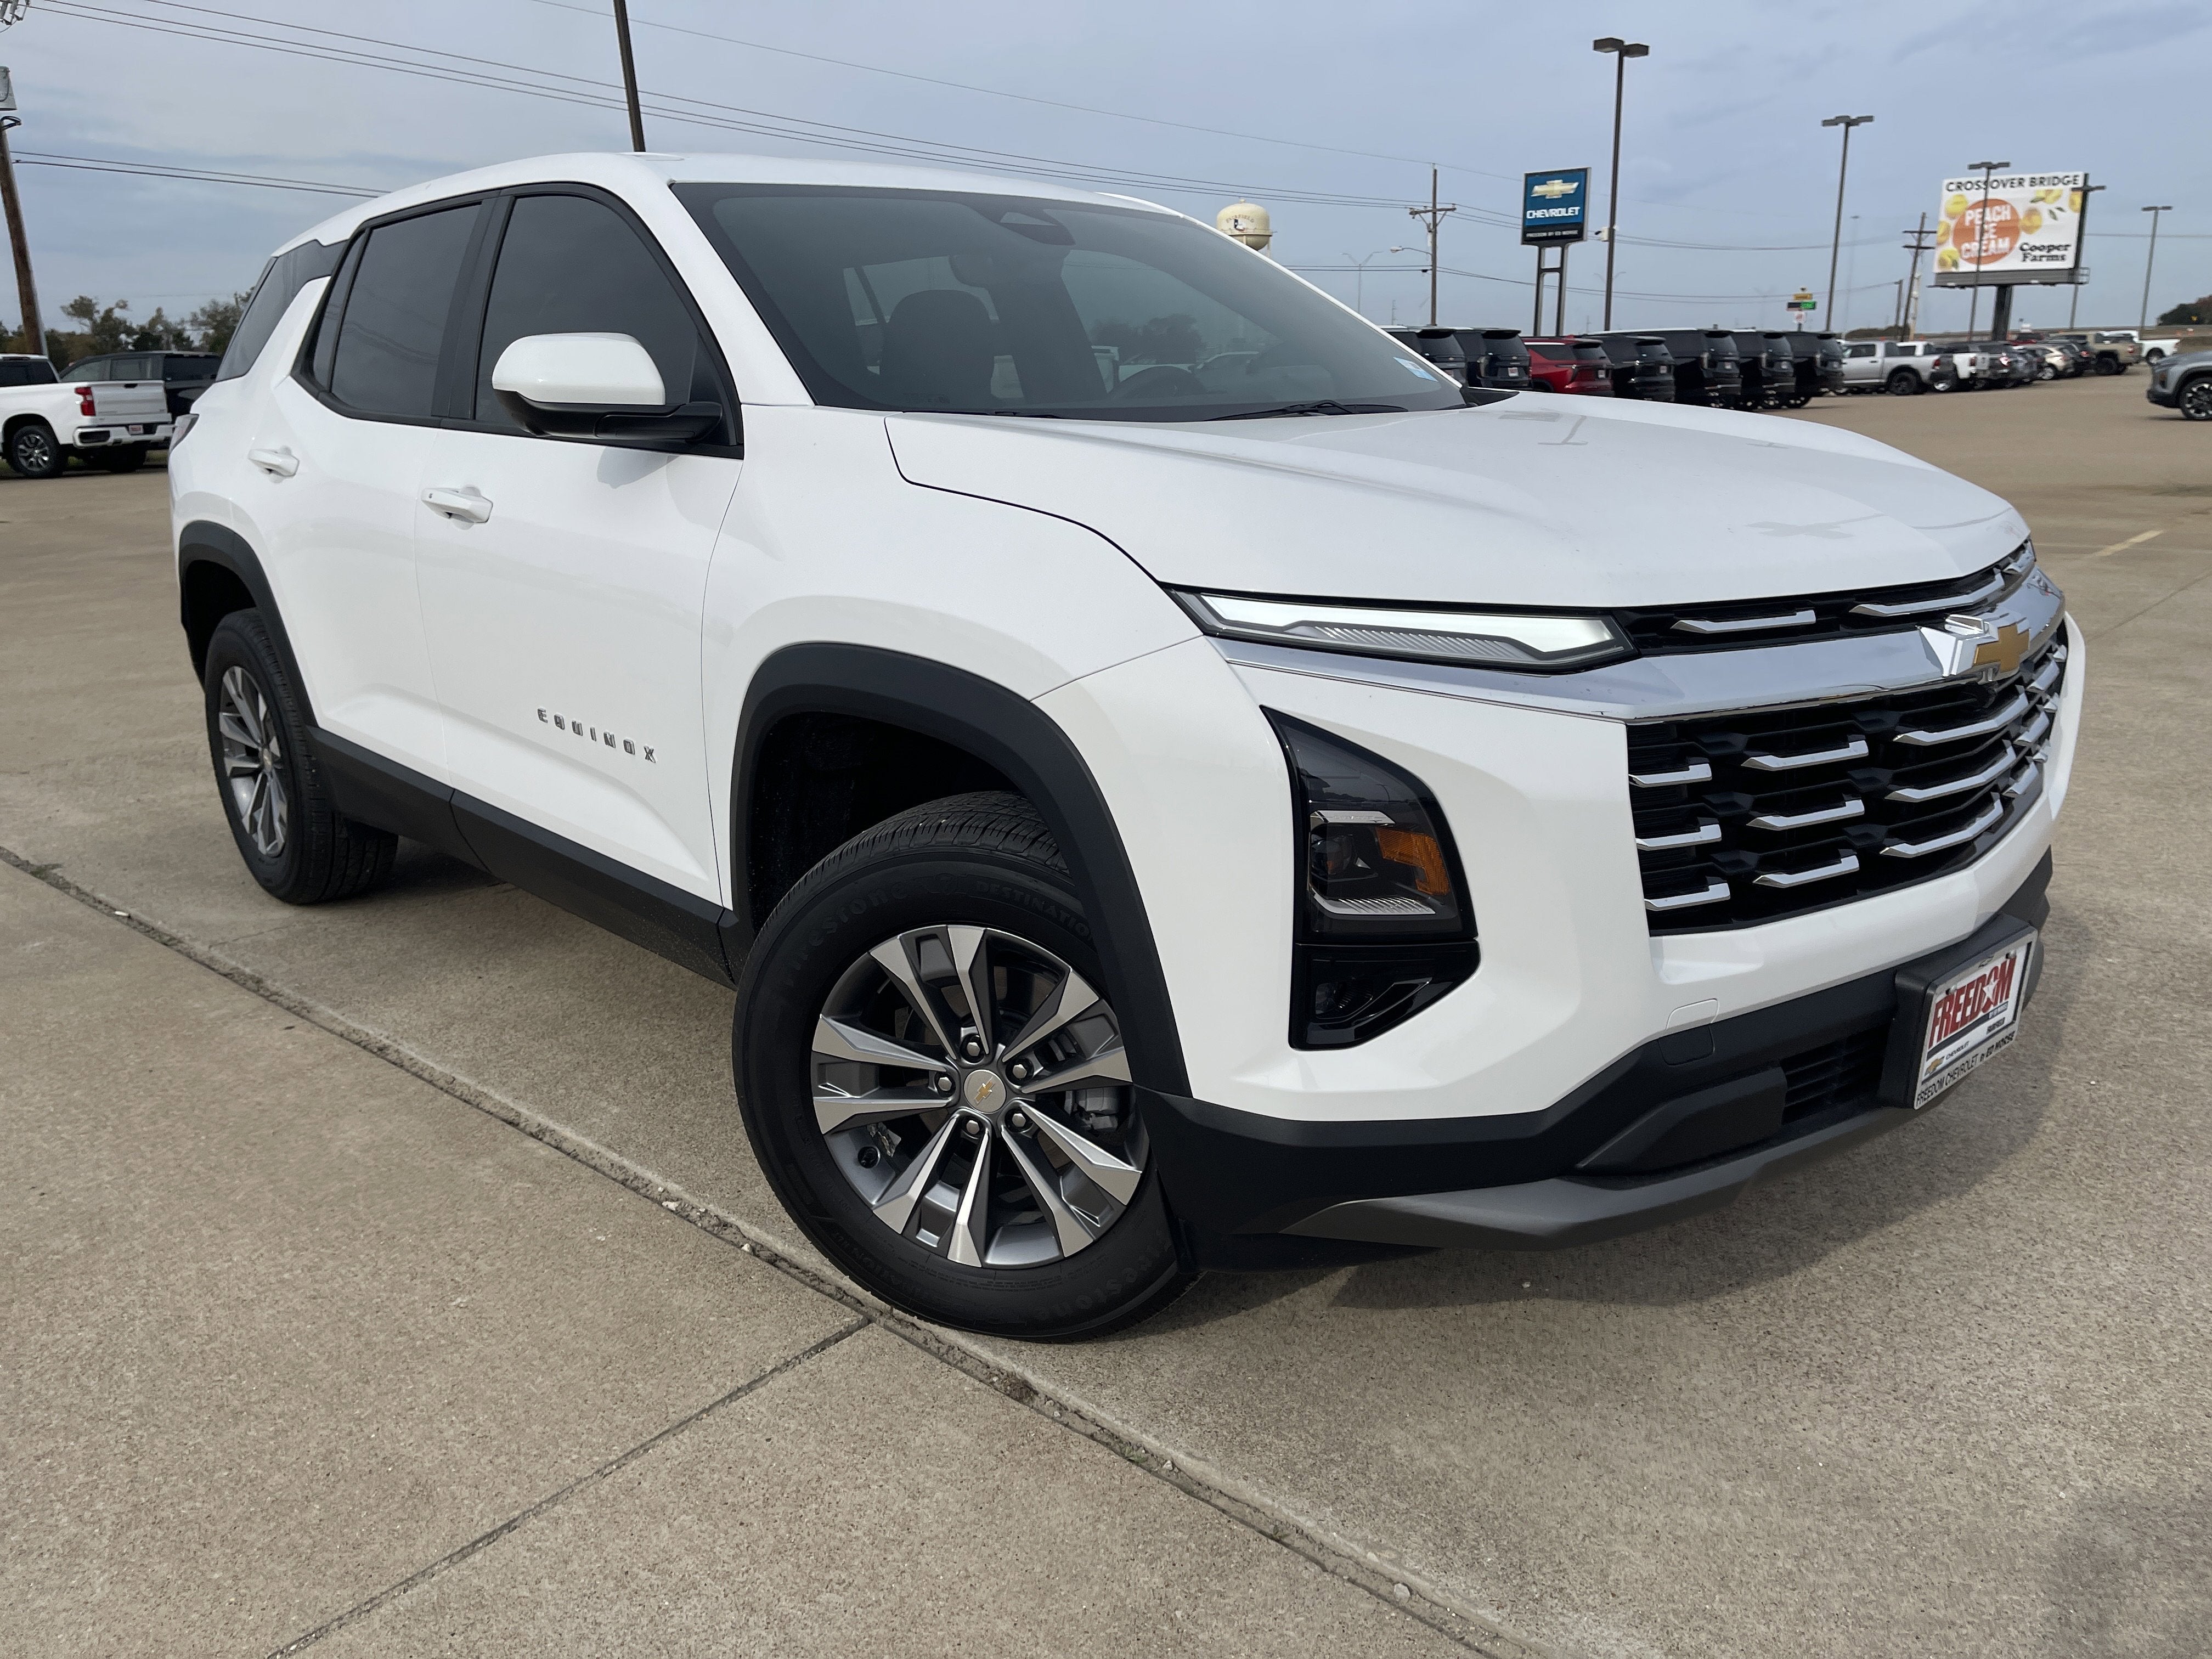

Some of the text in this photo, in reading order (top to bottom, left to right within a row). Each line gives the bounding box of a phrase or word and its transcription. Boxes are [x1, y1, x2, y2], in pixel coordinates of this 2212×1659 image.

[1946, 174, 2080, 192] CROSSOVER BRIDGE
[1526, 206, 1581, 219] CHEVROLET
[1965, 205, 2011, 227] PEACH
[1961, 237, 2010, 258] CREAM
[2019, 242, 2071, 253] Cooper
[2022, 252, 2066, 262] Farms
[537, 707, 657, 764] EQUINOX
[975, 880, 1094, 944] DESTINATIO
[1928, 956, 2017, 1049] FREEDOM
